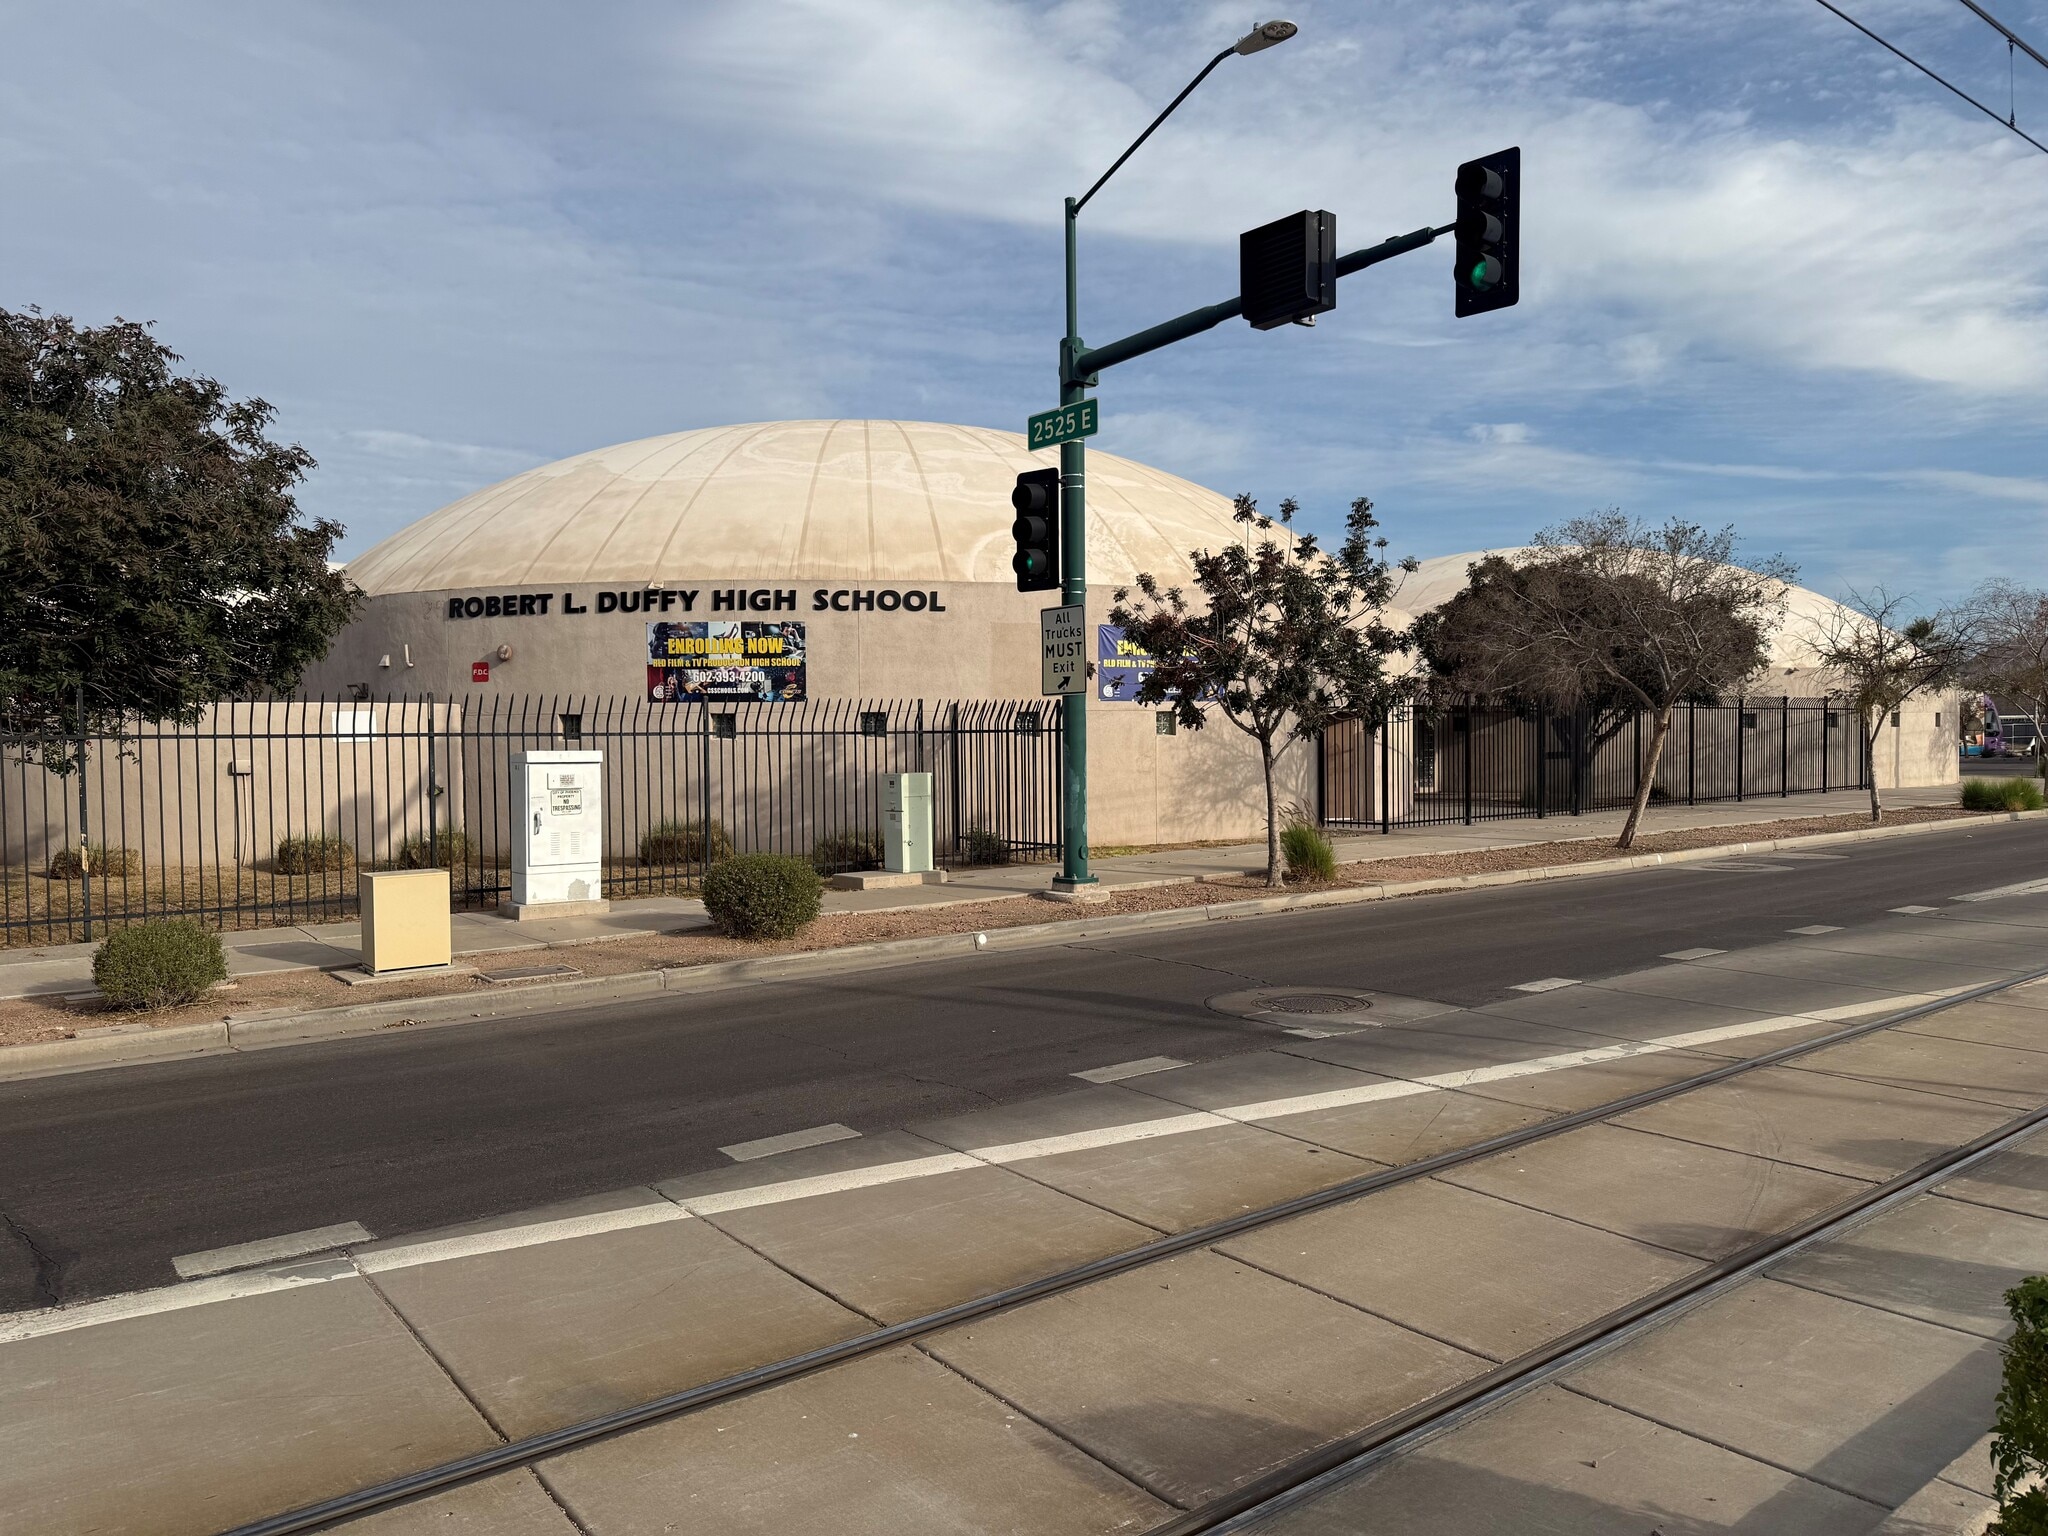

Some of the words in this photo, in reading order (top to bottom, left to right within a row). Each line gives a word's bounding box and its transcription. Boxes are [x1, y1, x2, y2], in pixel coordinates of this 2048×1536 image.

[1034, 412, 1076, 442] 2525
[1081, 408, 1091, 430] E
[449, 593, 553, 618] ROBERT
[565, 593, 586, 613] L.
[599, 590, 699, 612] DUFFY
[713, 589, 797, 611] HIGH
[813, 589, 946, 612] SCHOOL
[1055, 611, 1070, 624] All
[1045, 626, 1082, 640] Trucks
[668, 638, 744, 654] ENROLLING
[748, 638, 783, 654] NOW
[1045, 642, 1082, 659] MUST
[667, 659, 684, 668] FILM
[692, 659, 702, 668] TV
[703, 658, 750, 667] PRODUCTION
[751, 658, 770, 667] HIGH
[771, 658, 802, 667] SCHOOL
[1053, 661, 1075, 673] Exit
[1116, 659, 1131, 668] FILM
[1131, 660, 1137, 668] &
[693, 671, 765, 683] 602-393-4200
